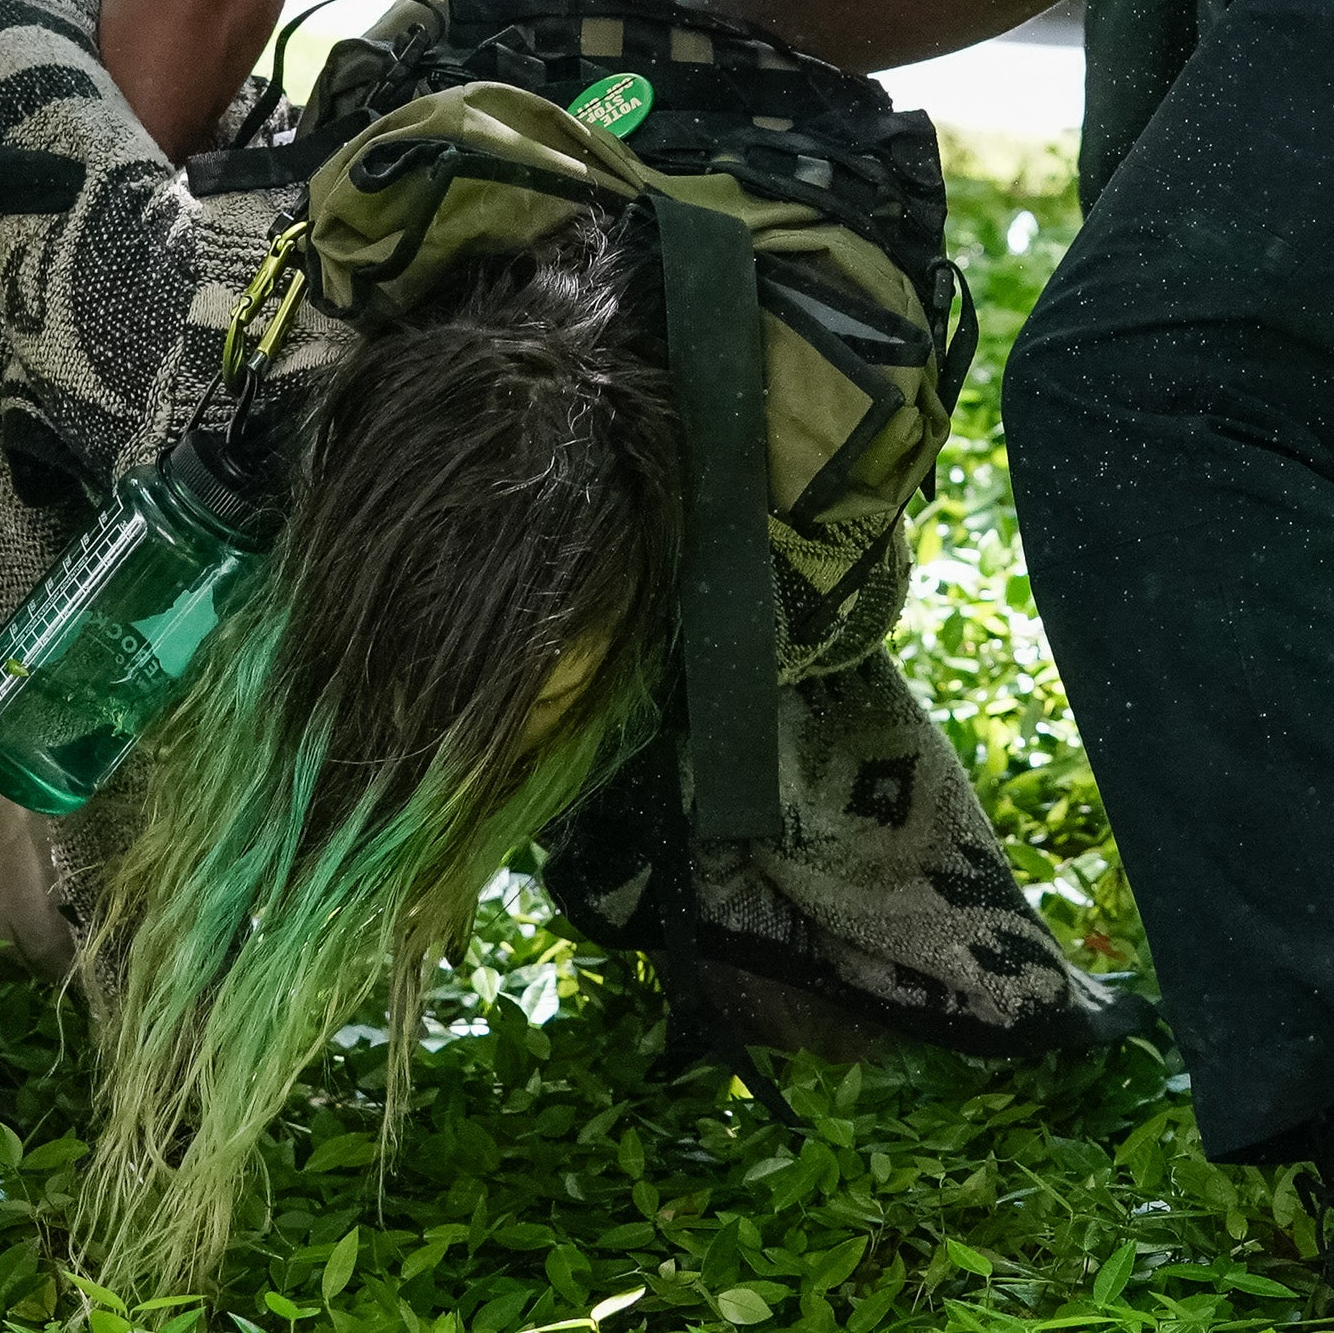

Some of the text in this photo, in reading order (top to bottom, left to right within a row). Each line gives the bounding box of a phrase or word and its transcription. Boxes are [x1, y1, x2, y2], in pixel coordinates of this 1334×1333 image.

[575, 97, 602, 119] CIT
[585, 94, 626, 124] STOP
[602, 96, 643, 128] VOTE
